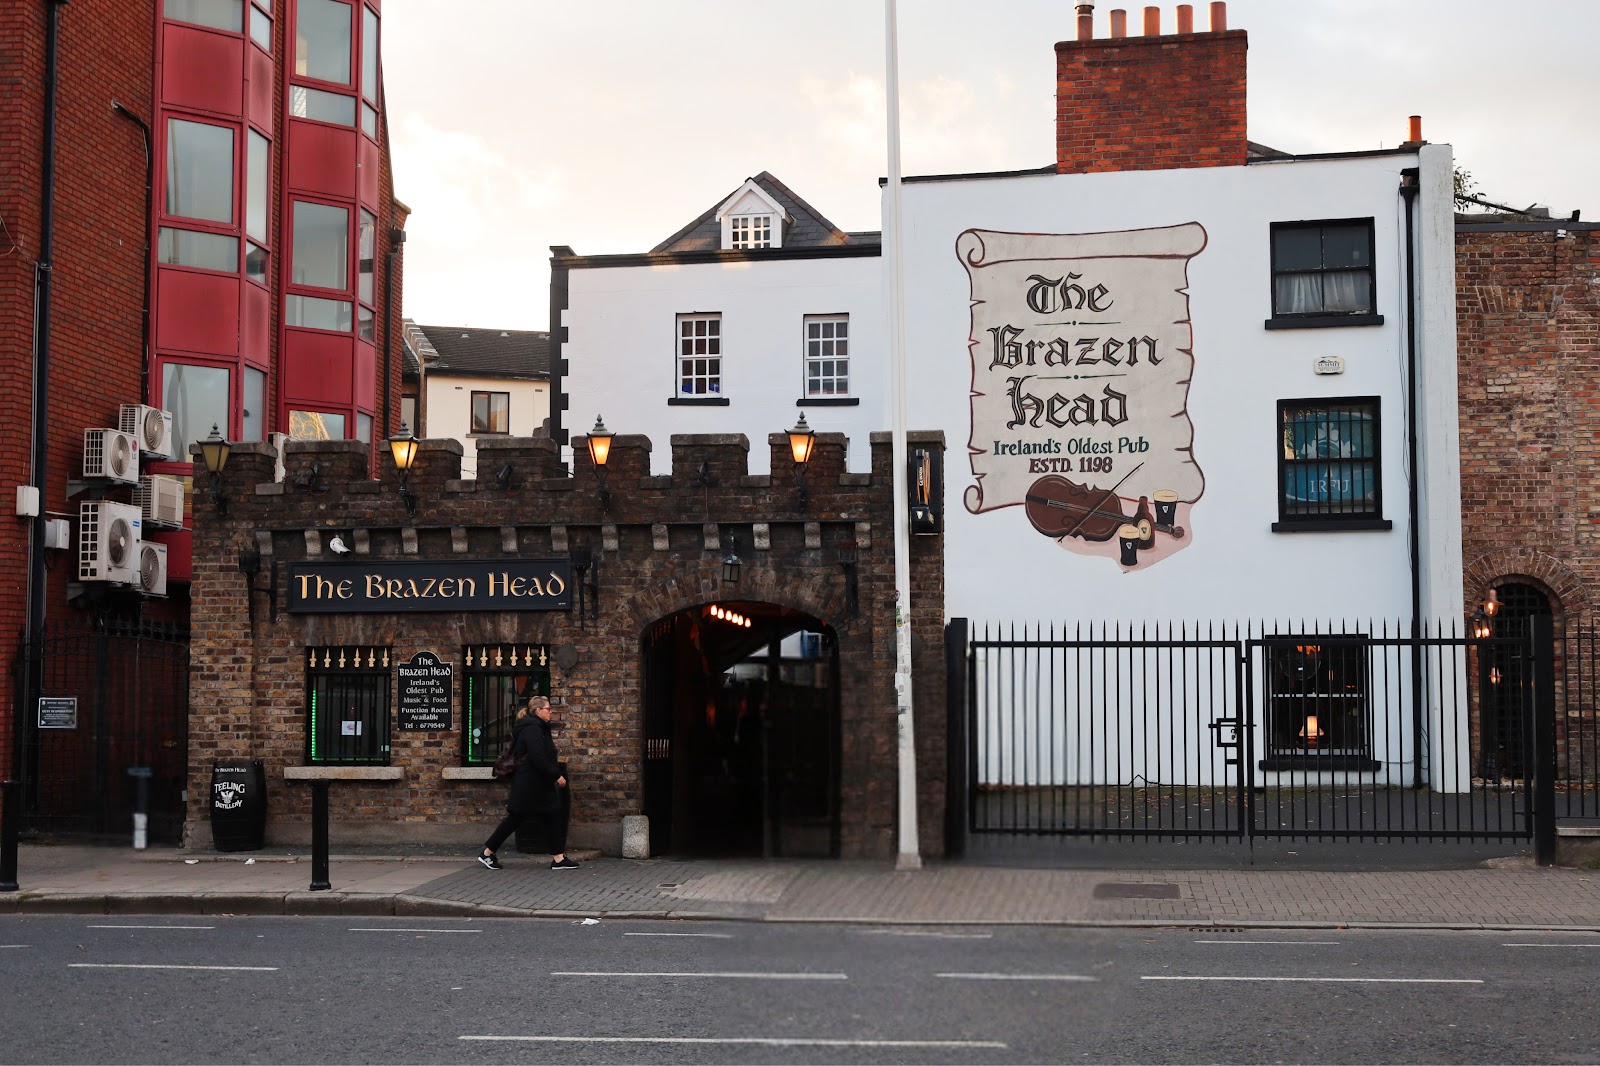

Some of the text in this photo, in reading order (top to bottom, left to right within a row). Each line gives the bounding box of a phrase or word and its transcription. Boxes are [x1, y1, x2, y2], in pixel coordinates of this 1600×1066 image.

[1025, 271, 1114, 314] The
[987, 324, 1165, 371] Brazen
[1006, 375, 1129, 431] Head
[993, 436, 1150, 456] Ireland's Oldest Pub
[1028, 456, 1113, 473] ESTD. 1198
[1310, 479, 1350, 493] IRFU
[294, 570, 565, 599] The Brazen Head
[418, 657, 434, 666] The
[430, 667, 451, 676] Head
[214, 782, 245, 793] TEELING
[215, 799, 243, 810] DISTILLERY
